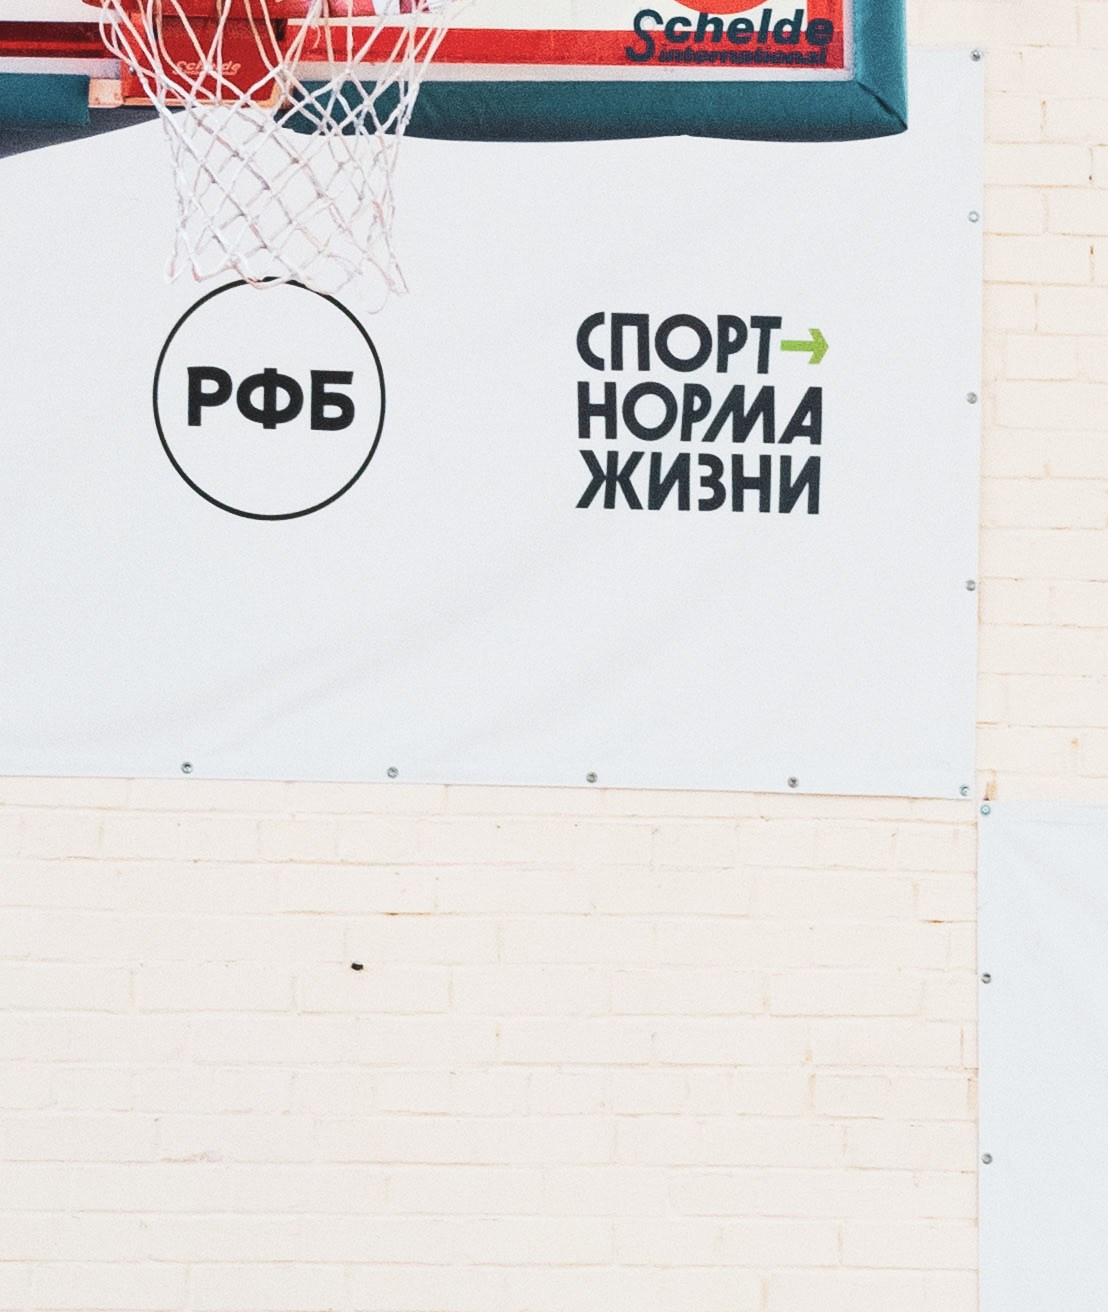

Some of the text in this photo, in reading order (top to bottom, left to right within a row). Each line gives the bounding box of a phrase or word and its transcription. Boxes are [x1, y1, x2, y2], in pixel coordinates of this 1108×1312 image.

[625, 8, 835, 62] Schelde
[576, 311, 782, 375] СПОРТ
[187, 366, 355, 432] РФБ
[577, 381, 823, 445] НОРМА
[576, 449, 821, 515] ЖИЗНИ
